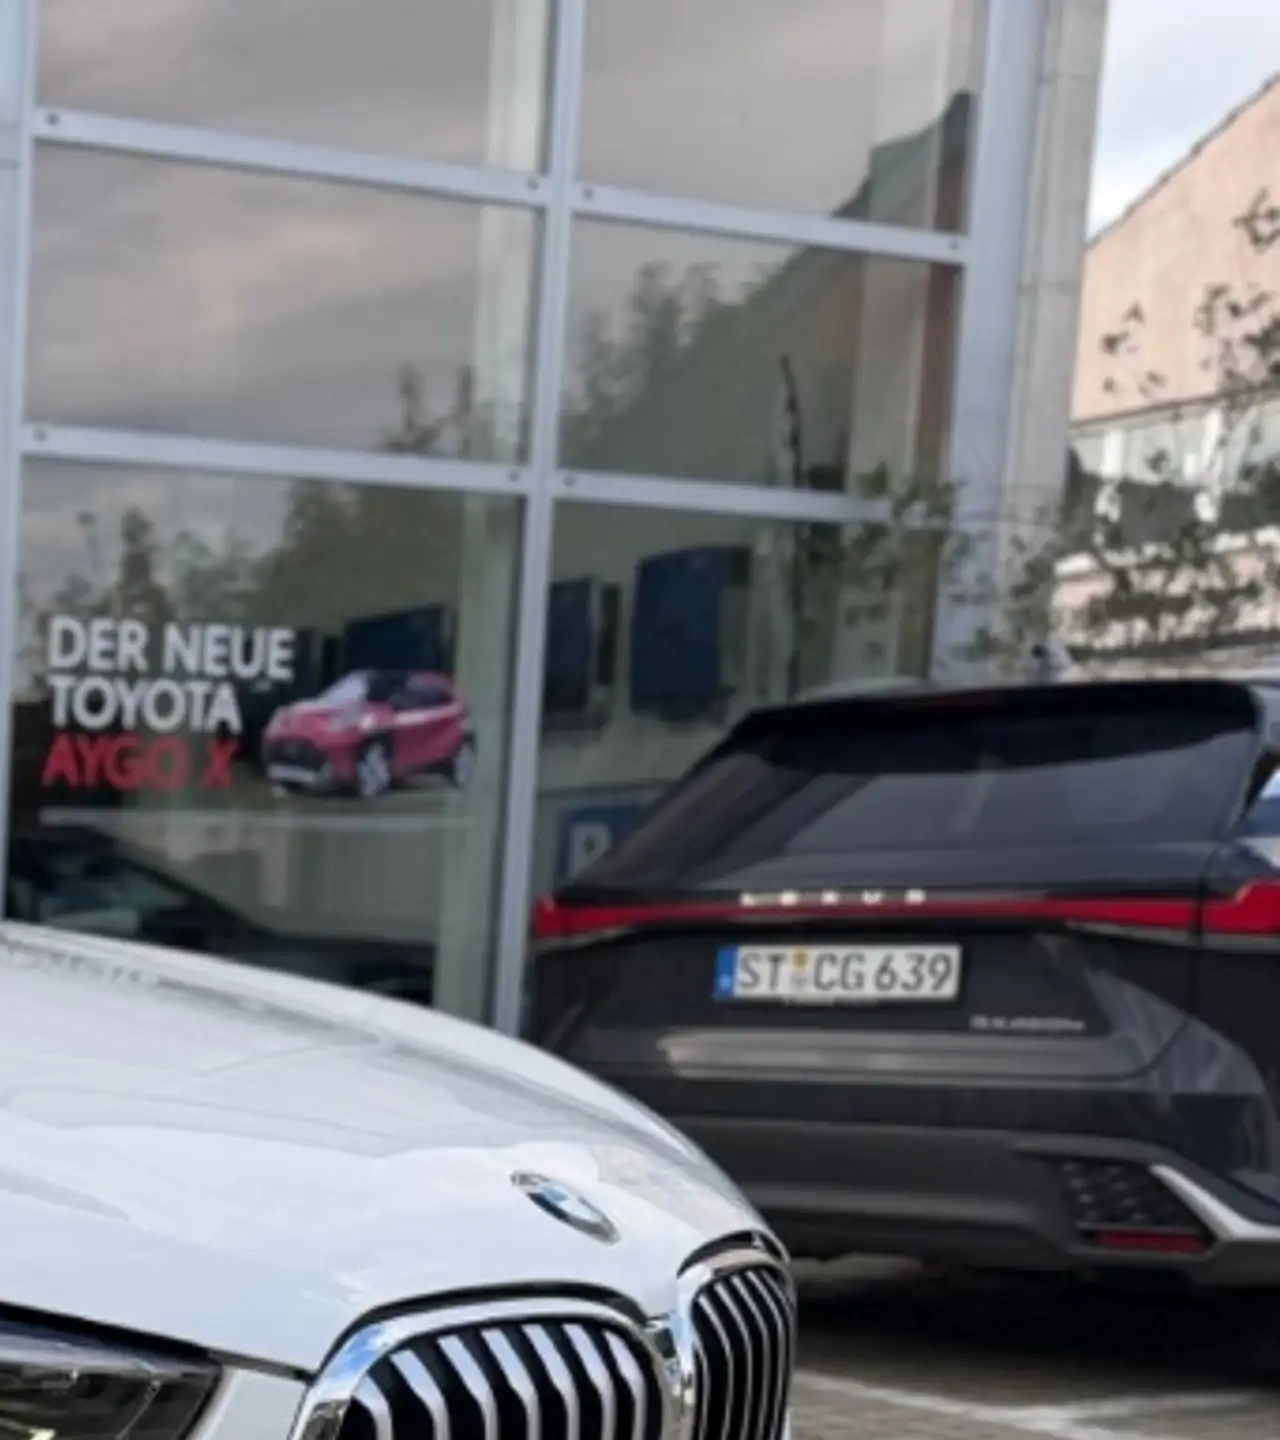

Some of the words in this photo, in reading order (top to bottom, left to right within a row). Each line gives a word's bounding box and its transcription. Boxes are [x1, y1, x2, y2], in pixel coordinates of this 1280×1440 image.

[47, 615, 149, 672] DER
[162, 623, 296, 682] NEUE
[45, 673, 244, 734] TOYOTA
[41, 733, 190, 792] AYGO
[201, 736, 240, 790] X
[739, 952, 787, 991] ST
[813, 952, 865, 993] CG
[875, 953, 953, 993] 639
